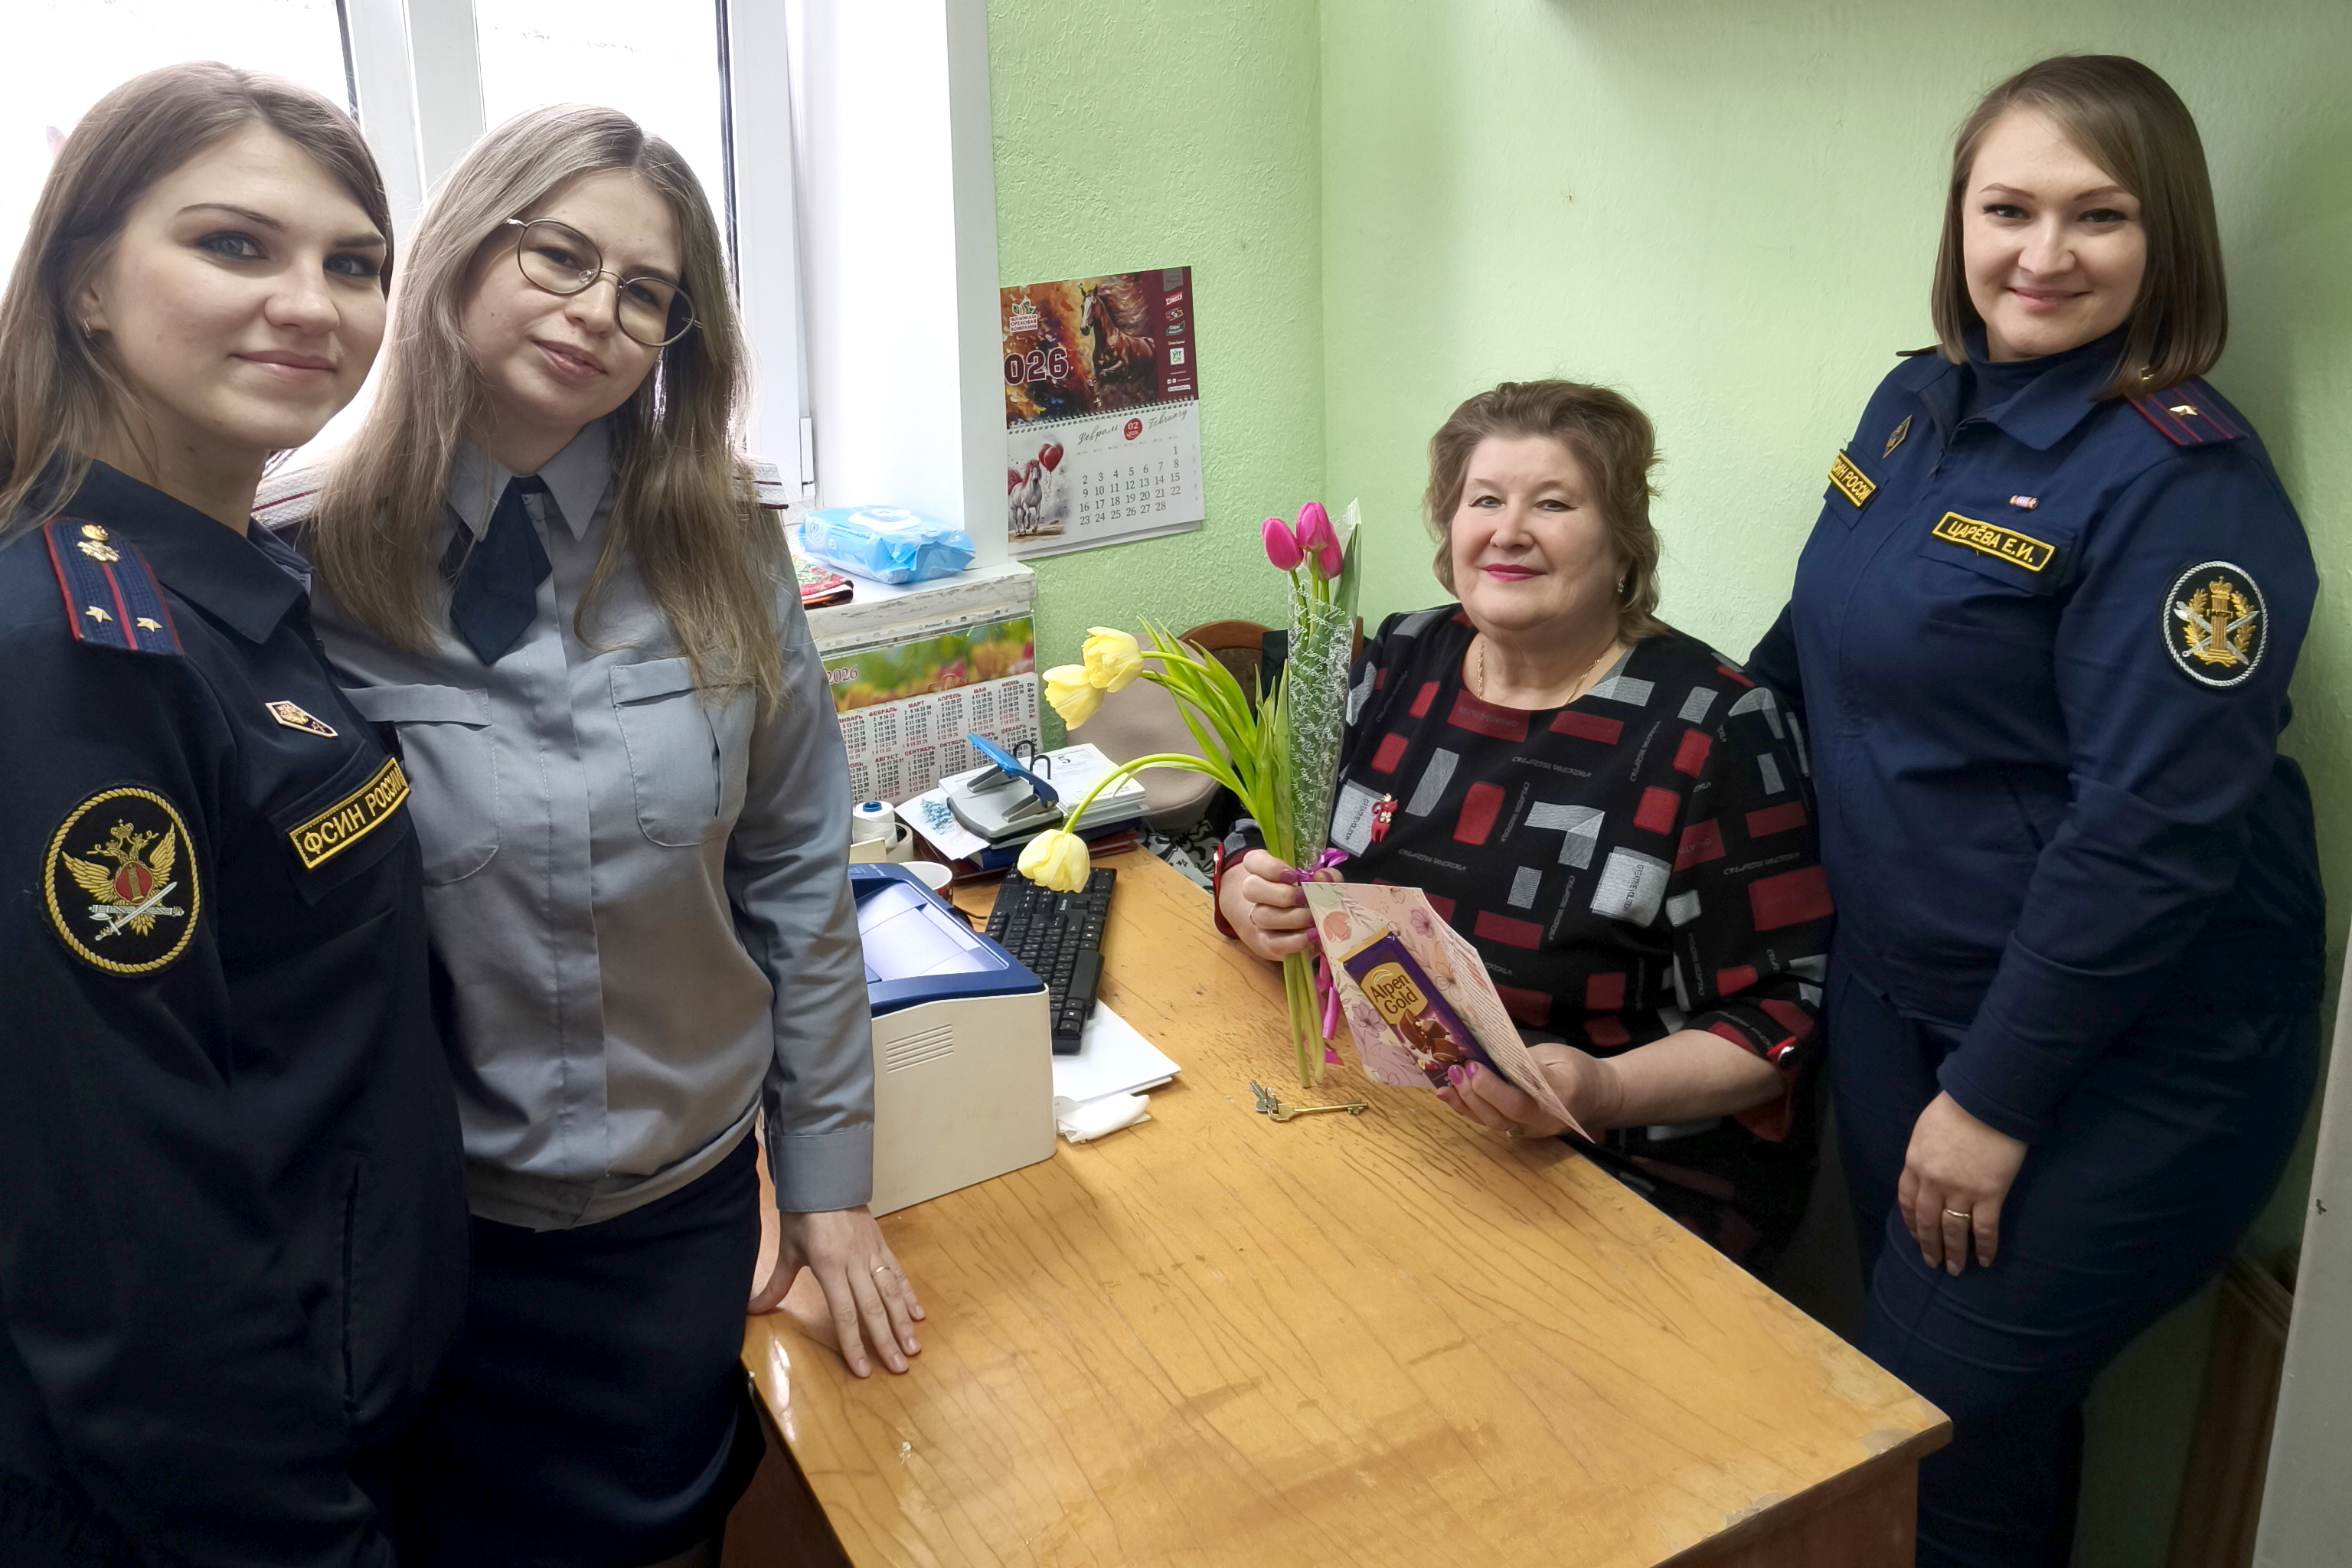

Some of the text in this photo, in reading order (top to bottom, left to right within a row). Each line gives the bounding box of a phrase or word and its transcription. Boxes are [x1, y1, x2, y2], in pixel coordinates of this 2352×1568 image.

[1128, 421, 1138, 430] 02
[1148, 410, 1187, 430] February
[1174, 446, 1178, 455] 1
[1083, 459, 1178, 485] 2 3 4 5 6 7 8
[1083, 472, 1180, 498] 9 10 11 12 13 14 15
[1080, 486, 1181, 512] 16 17 18 19 20 21 22
[1080, 501, 1166, 525] 23 24 25 26 27 28
[1947, 521, 2034, 563] ЦАРЁВА Е.И.
[826, 665, 858, 684] 2026
[875, 753, 898, 763] АВГУСТ
[1058, 755, 1071, 764] 5
[304, 766, 405, 854] ФСИН РОССИИ
[1370, 974, 1410, 1003] Alpen
[1384, 986, 1419, 1014] Gold
